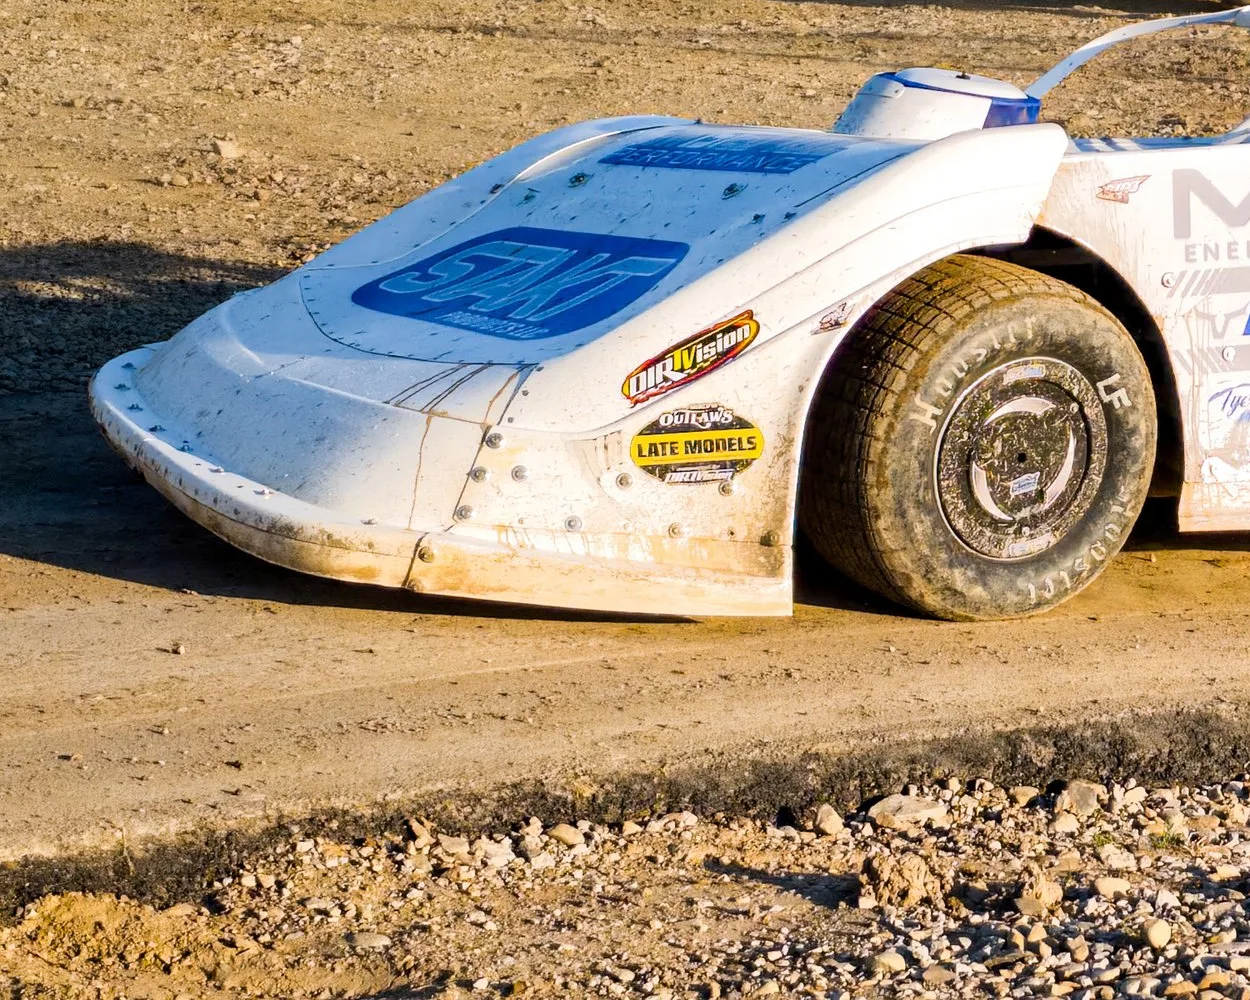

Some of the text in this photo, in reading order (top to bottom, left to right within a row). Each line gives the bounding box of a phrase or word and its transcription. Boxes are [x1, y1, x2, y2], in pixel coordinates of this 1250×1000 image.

[378, 240, 678, 322] STAKT
[629, 322, 751, 398] DIRTVision
[658, 406, 734, 429] OUTLAWS
[637, 436, 757, 458] LATE MODELS
